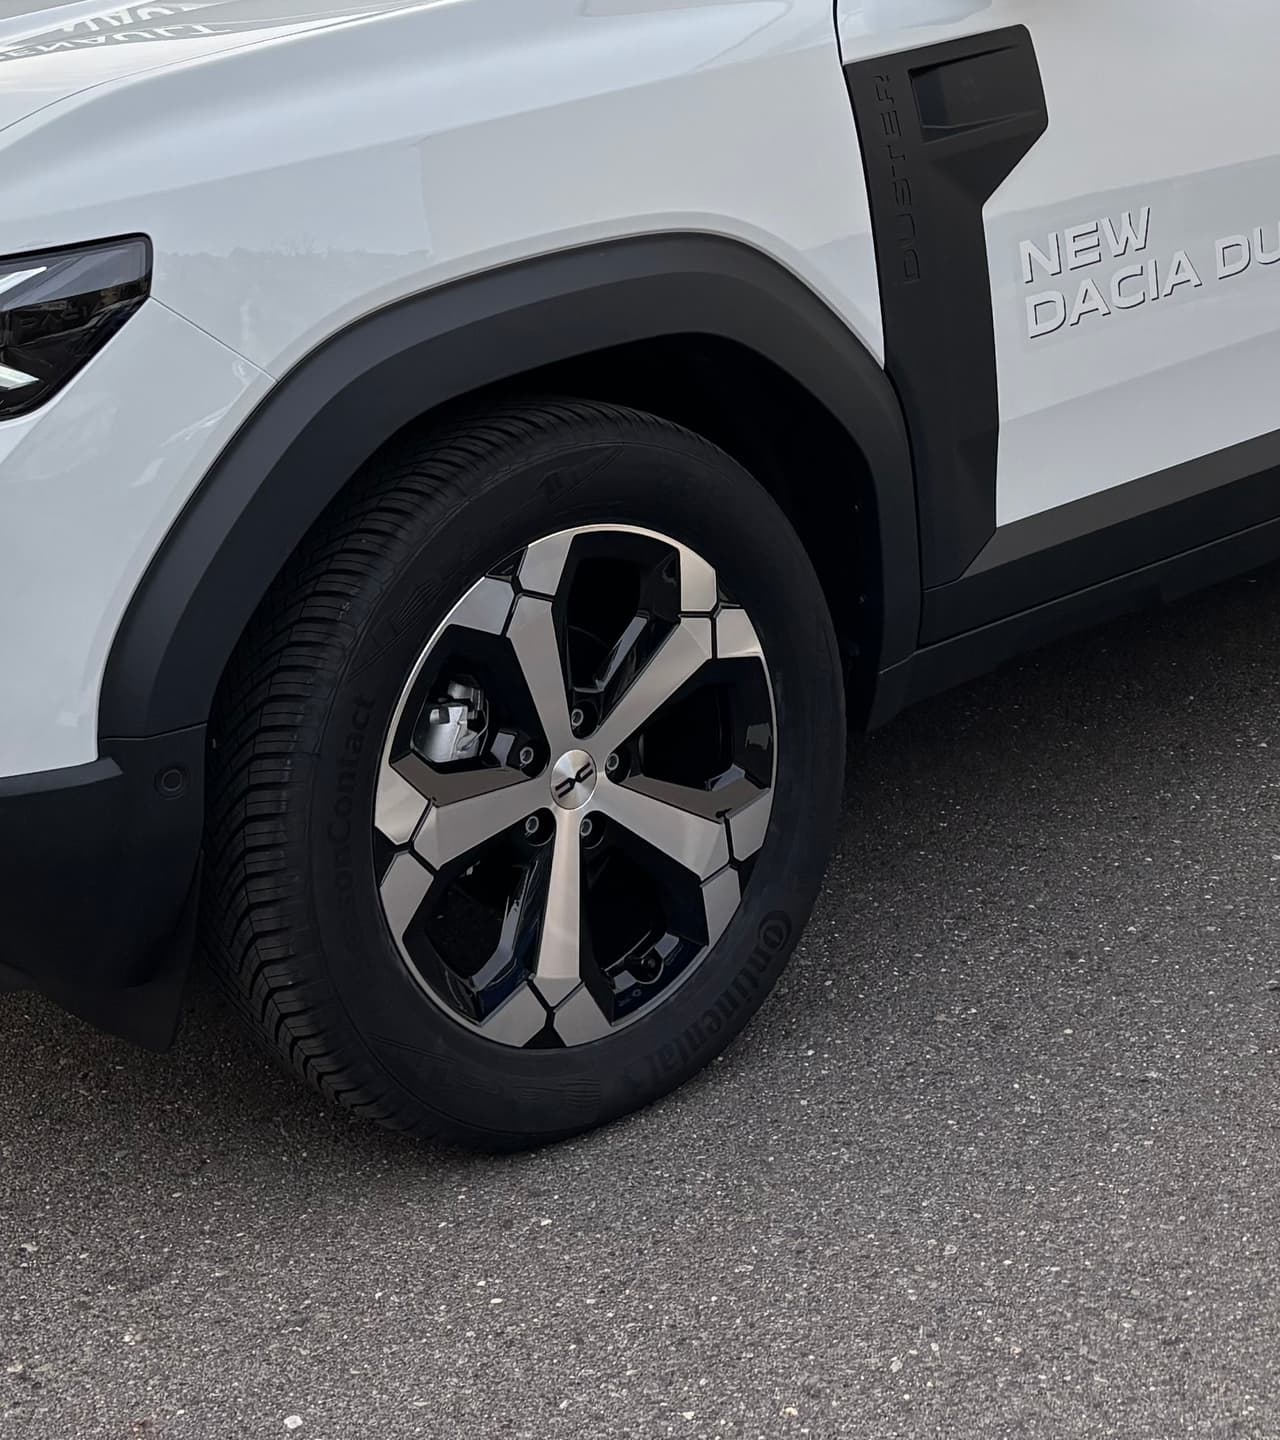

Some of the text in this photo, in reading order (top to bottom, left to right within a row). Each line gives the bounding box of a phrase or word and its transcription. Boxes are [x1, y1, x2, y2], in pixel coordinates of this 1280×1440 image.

[872, 73, 921, 285] DUSTER
[1019, 206, 1151, 285] NEW
[1024, 249, 1203, 340] DACIA
